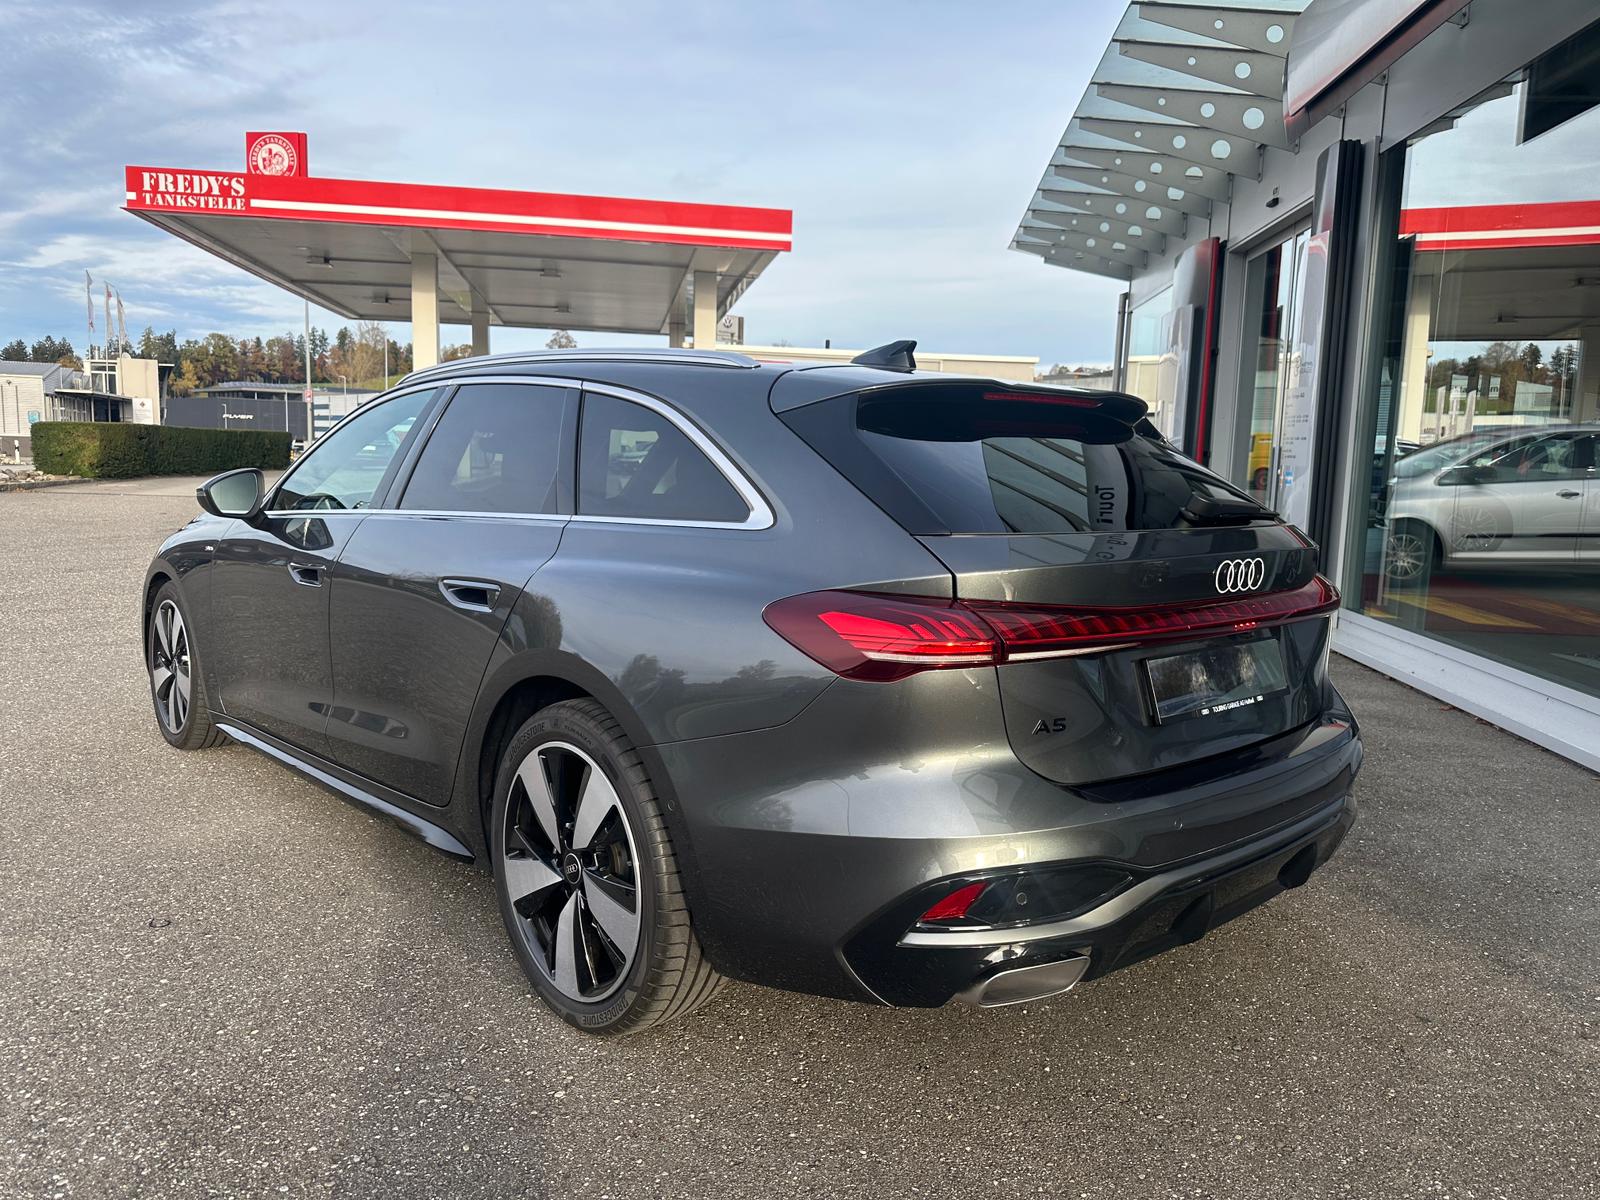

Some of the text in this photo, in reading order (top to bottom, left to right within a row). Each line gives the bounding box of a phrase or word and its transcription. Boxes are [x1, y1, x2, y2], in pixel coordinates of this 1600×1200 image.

[142, 172, 245, 197] FREDY'S
[142, 192, 246, 211] TANKSTELLE
[1032, 717, 1066, 735] A5
[582, 997, 629, 1026] BRIDGESTONE
